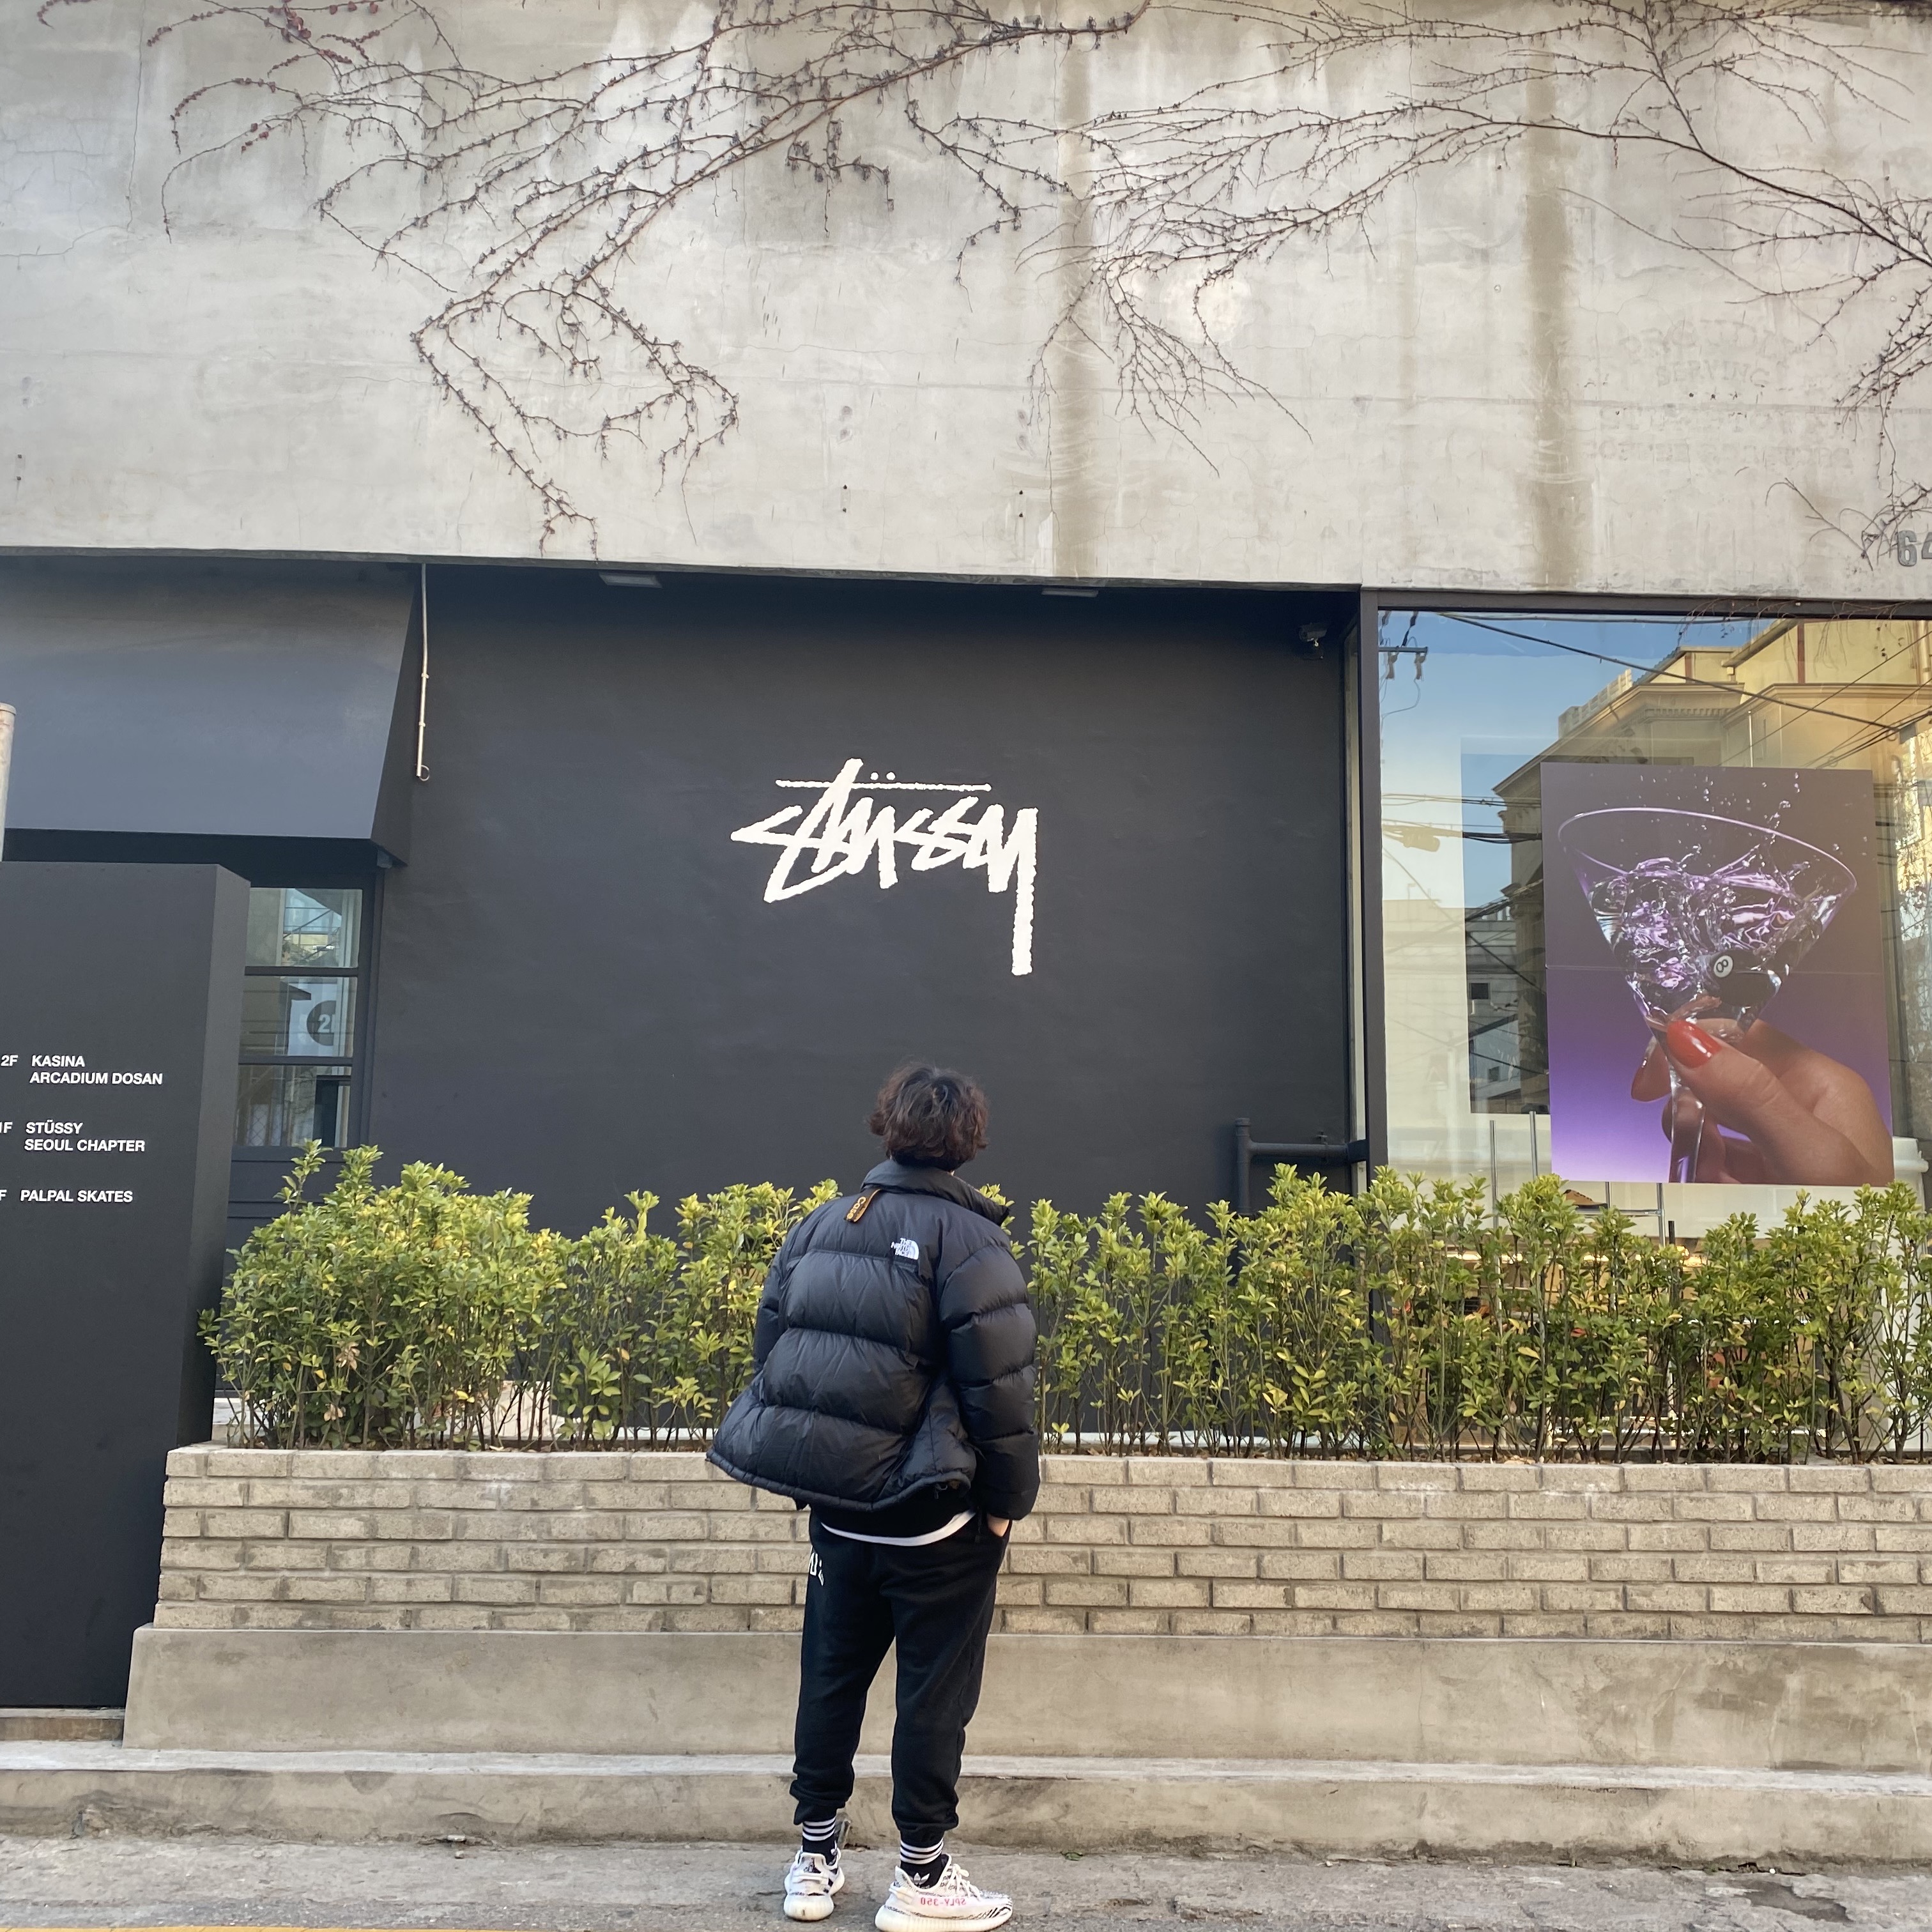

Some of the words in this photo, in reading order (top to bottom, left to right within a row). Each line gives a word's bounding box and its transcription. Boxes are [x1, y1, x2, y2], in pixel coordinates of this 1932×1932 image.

[1715, 959, 1729, 973] 8
[1, 1055, 18, 1066] 2F
[31, 1055, 85, 1067] KASINA
[29, 1072, 108, 1084] ARCADIUM
[112, 1073, 162, 1085] DOSAN
[26, 1119, 83, 1134] STÜSSY
[24, 1138, 73, 1151] SEOUL
[77, 1140, 145, 1152] CHAPTER
[20, 1190, 73, 1202] PALPAL
[77, 1190, 133, 1202] SKATES
